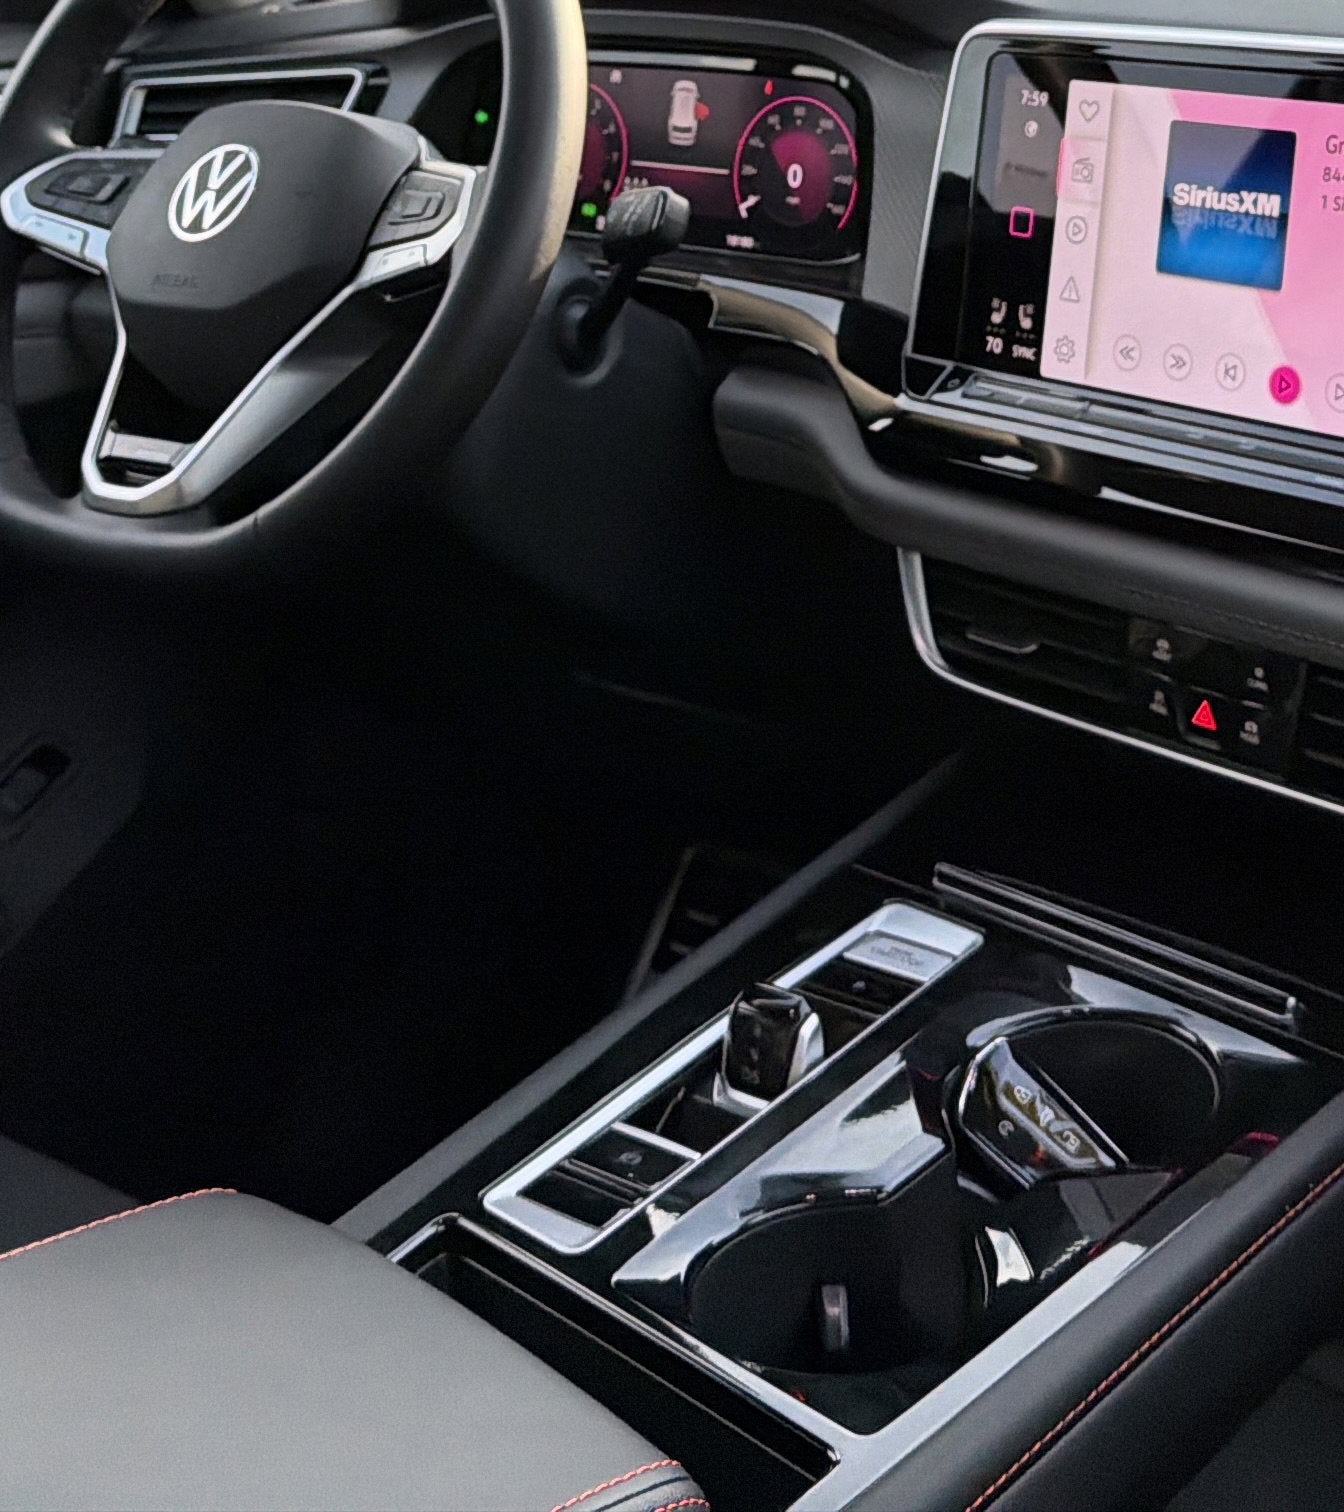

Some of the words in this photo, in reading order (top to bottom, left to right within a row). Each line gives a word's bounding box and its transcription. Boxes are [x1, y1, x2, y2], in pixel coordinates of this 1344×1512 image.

[1021, 89, 1049, 106] 7:59
[787, 163, 803, 188] 0
[1172, 182, 1281, 218] SiriusXM
[1321, 194, 1328, 210] 1
[986, 335, 1004, 355] 70
[1011, 344, 1038, 361] SYNC
